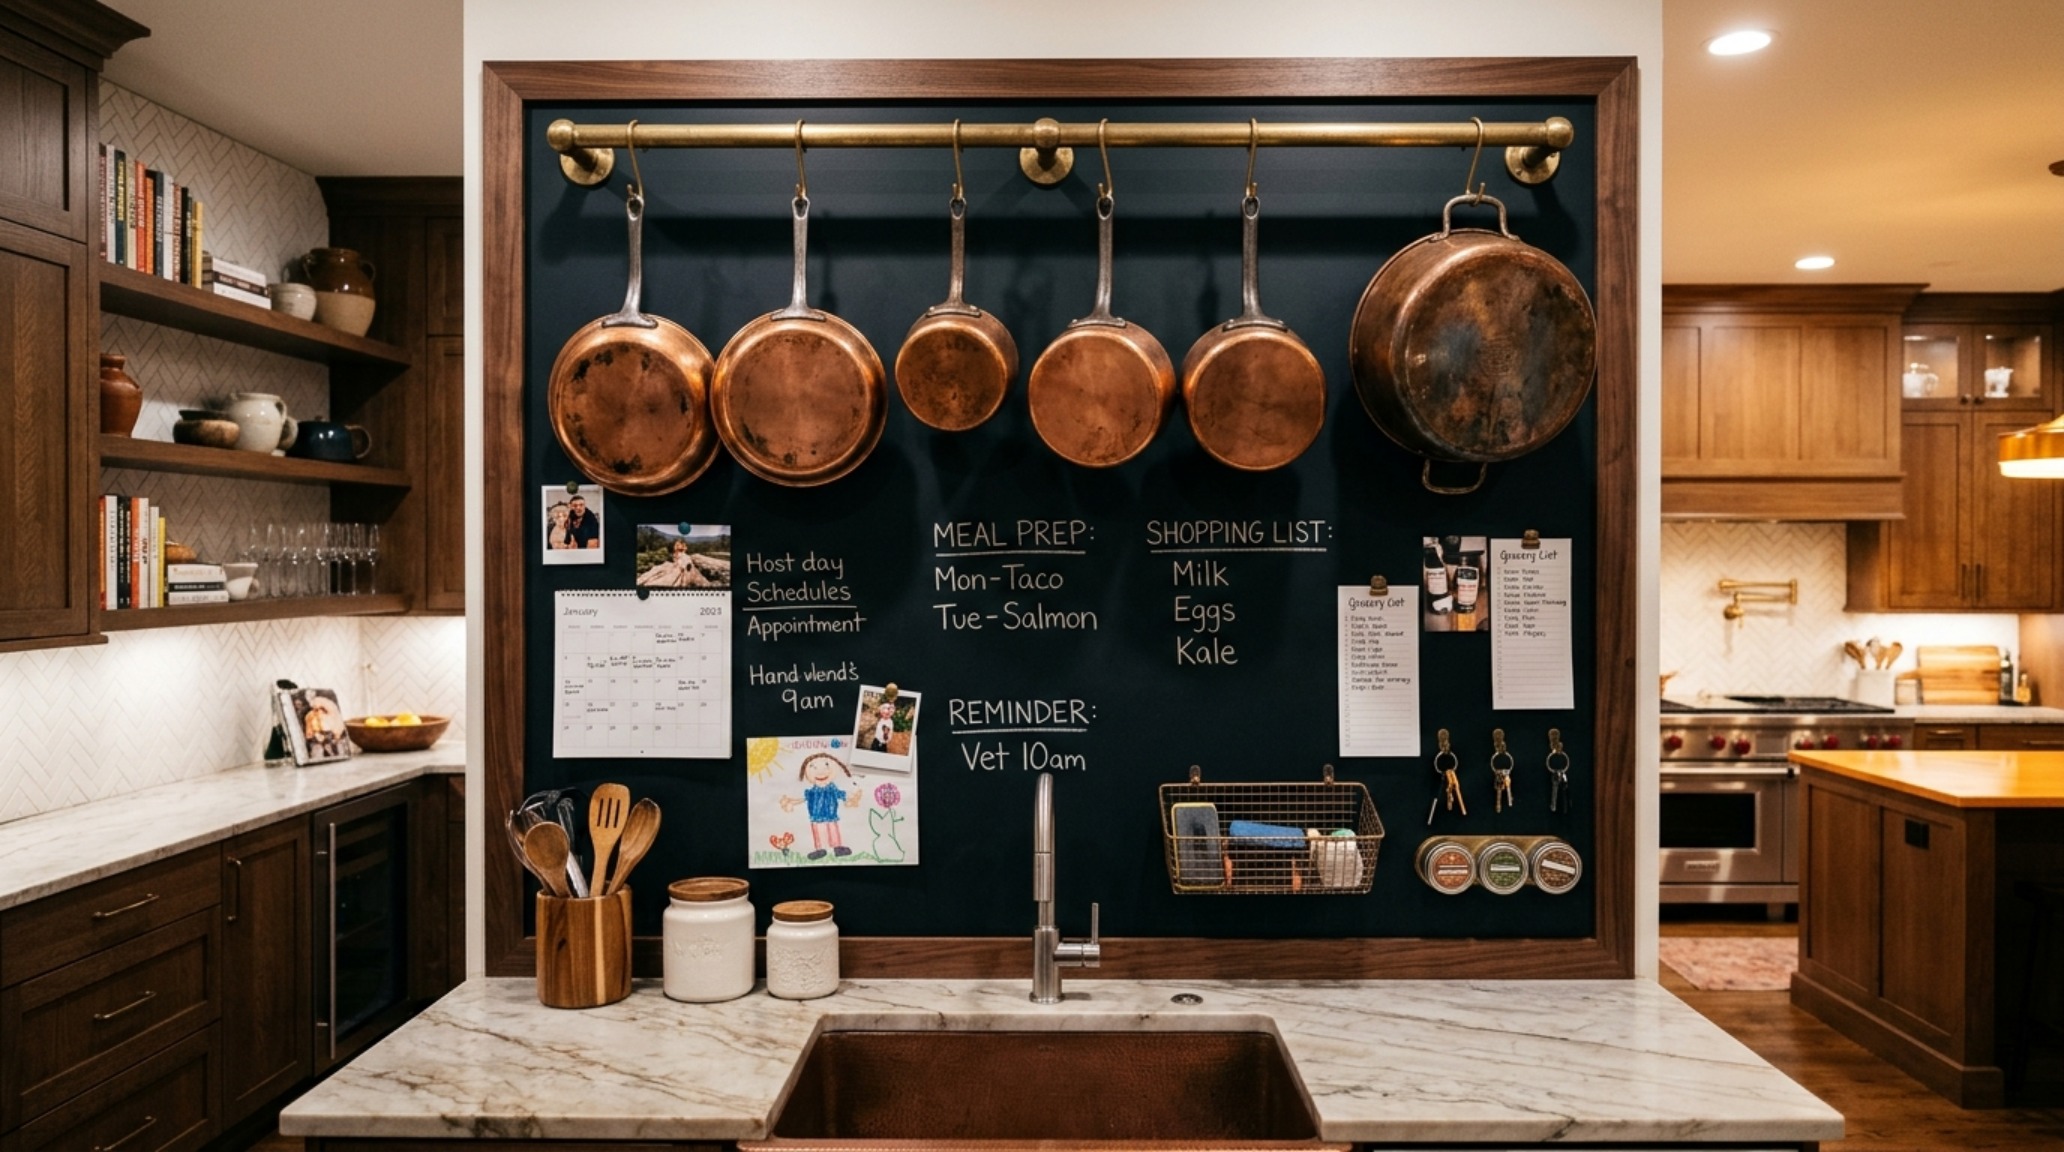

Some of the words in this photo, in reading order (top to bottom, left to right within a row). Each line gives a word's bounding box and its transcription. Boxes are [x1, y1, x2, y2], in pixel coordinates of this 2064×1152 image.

[933, 521, 1007, 548] MEAL
[1017, 519, 1095, 545] PREP:
[1146, 520, 1264, 545] SHOPPING
[1273, 519, 1333, 544] LIST:
[746, 552, 795, 573] Host
[801, 551, 844, 580] day
[1173, 560, 1229, 587] Milk
[747, 580, 852, 603] Schedules
[747, 611, 867, 642] Appointment
[1174, 595, 1236, 633] Eggs
[1176, 636, 1239, 665] Kale
[781, 688, 834, 713] 9am
[948, 698, 1097, 726] REMINDER:
[960, 741, 1010, 771] Vet
[1022, 740, 1086, 771] 10am
